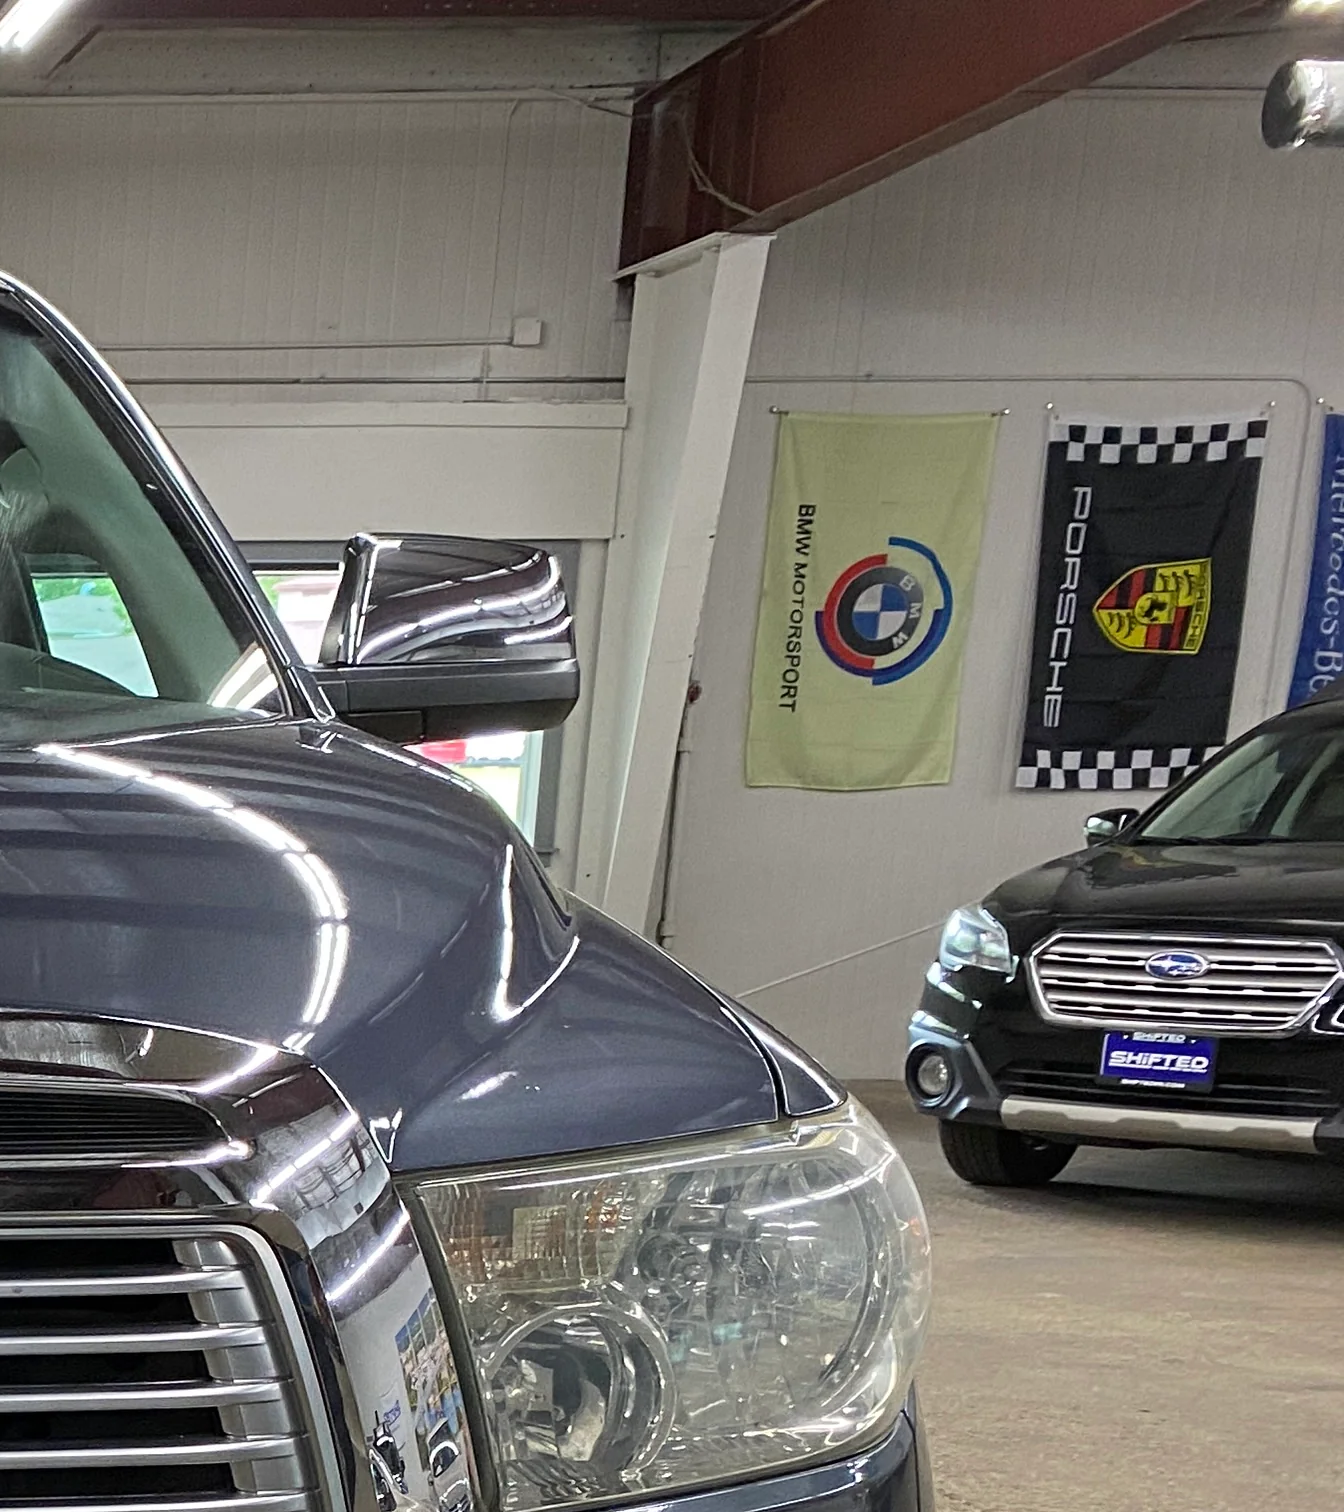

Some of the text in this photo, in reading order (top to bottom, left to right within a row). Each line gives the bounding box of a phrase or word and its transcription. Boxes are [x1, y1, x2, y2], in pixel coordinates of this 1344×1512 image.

[778, 504, 816, 713] BMW MOTORSPORT
[1043, 486, 1092, 728] PORSCHE
